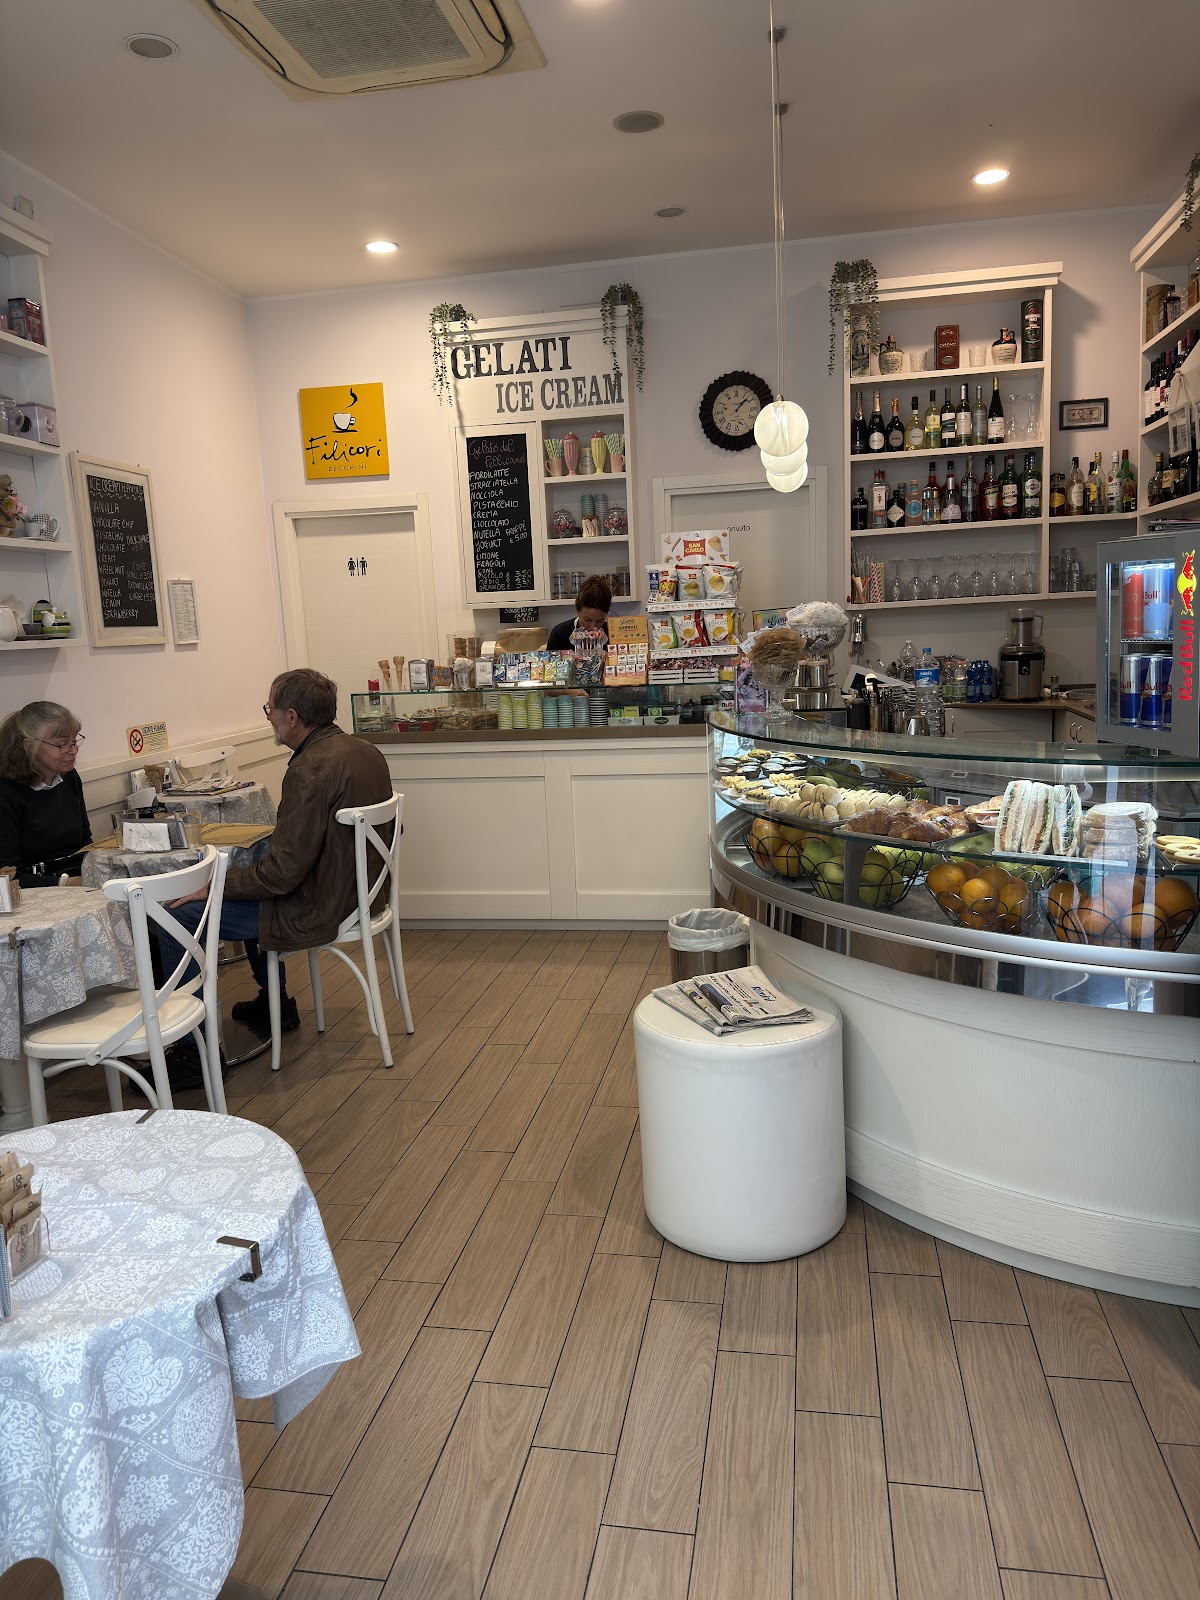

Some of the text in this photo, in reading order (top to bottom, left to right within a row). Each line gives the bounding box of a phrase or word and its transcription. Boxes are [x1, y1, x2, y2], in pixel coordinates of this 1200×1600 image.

[450, 336, 572, 380] GELATI
[496, 372, 624, 413] ICE CREAM
[305, 435, 382, 465] Filicori
[328, 464, 367, 472] ZECCHINI
[471, 489, 504, 501] NOCCIOLA
[473, 510, 499, 519] CREMA
[474, 528, 501, 539] NUTELLA
[476, 552, 500, 560] LIMONE
[477, 560, 506, 568] FRAGOLA
[1178, 618, 1195, 701] Red Bull
